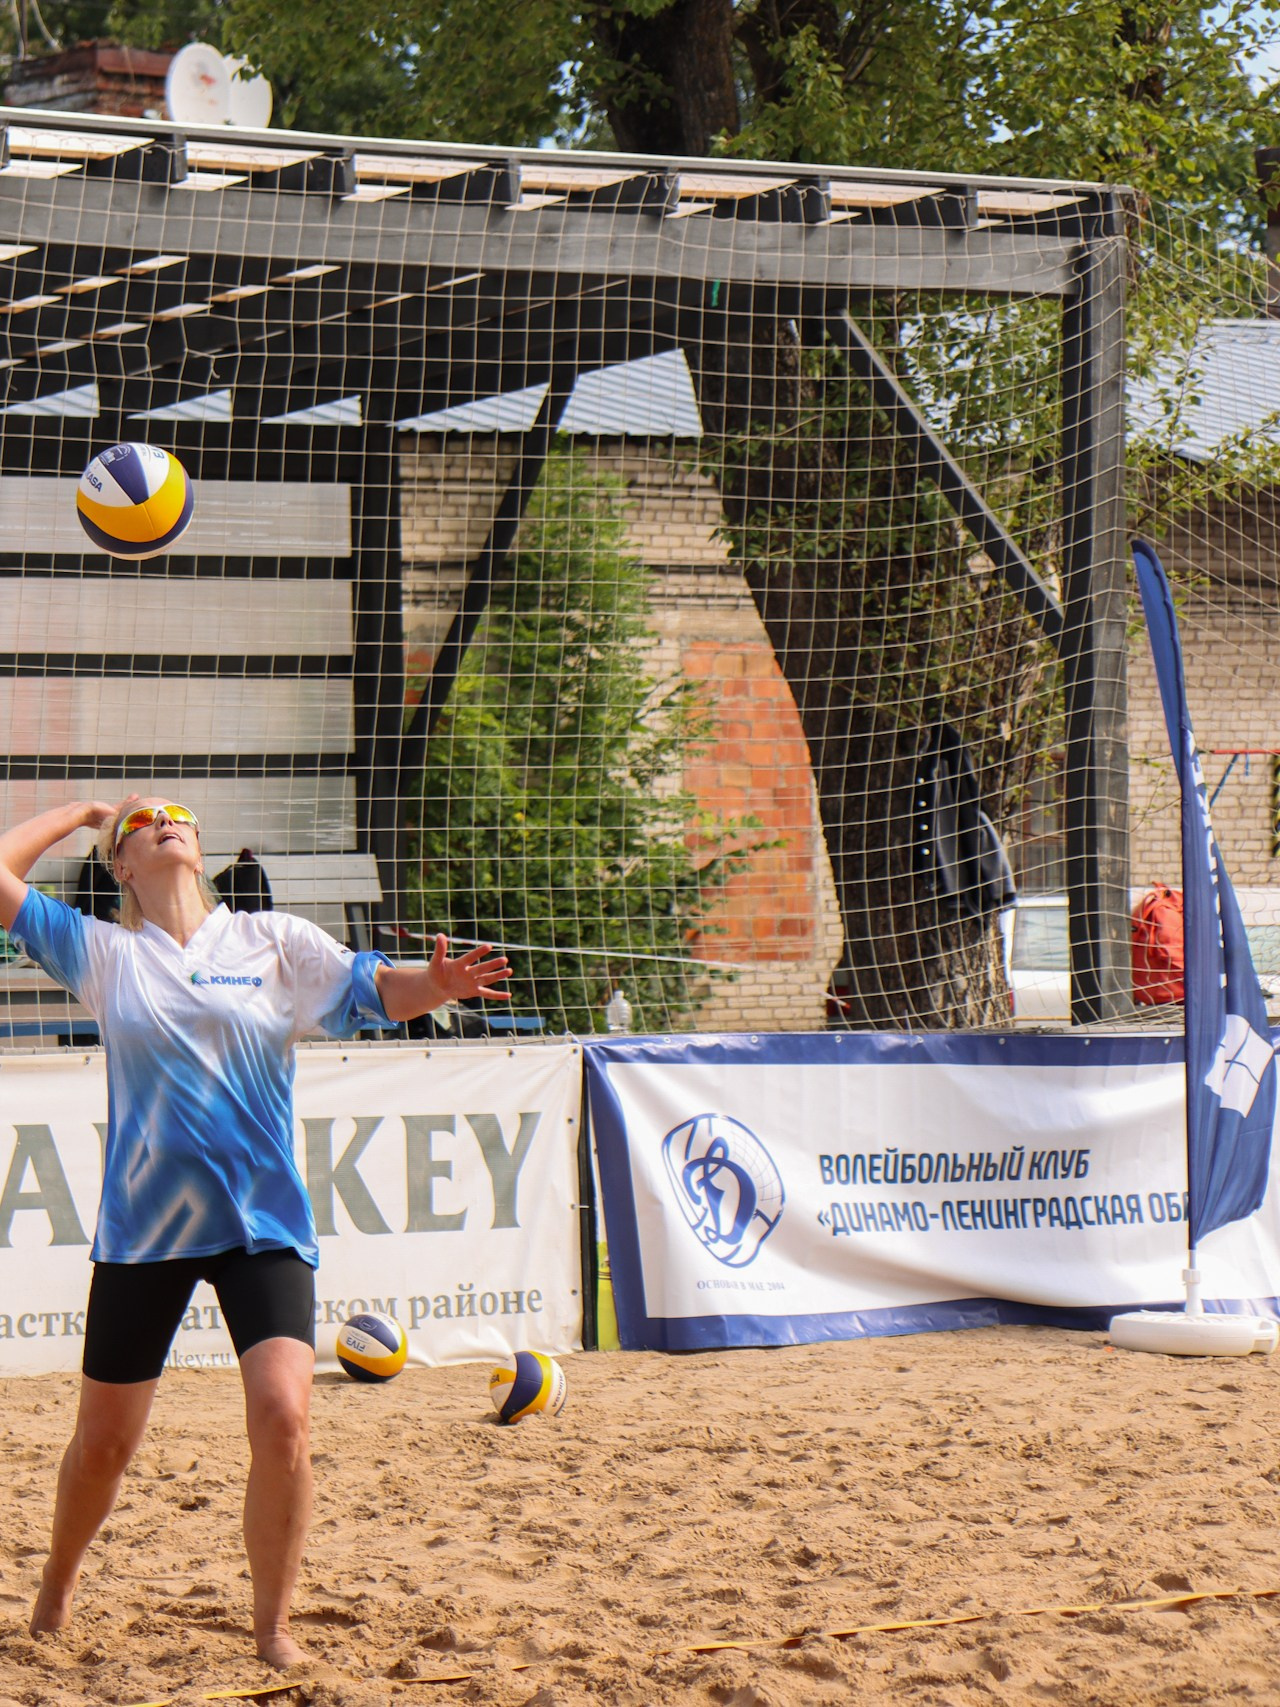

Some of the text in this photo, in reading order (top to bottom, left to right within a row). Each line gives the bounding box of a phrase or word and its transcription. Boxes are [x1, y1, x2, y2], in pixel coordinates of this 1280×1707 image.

[210, 975, 262, 987] КИНЕФ
[819, 1146, 1091, 1185] ВОЛЕЙБОЛЬНЫЙ КЛУБ
[408, 1283, 542, 1329] районе
